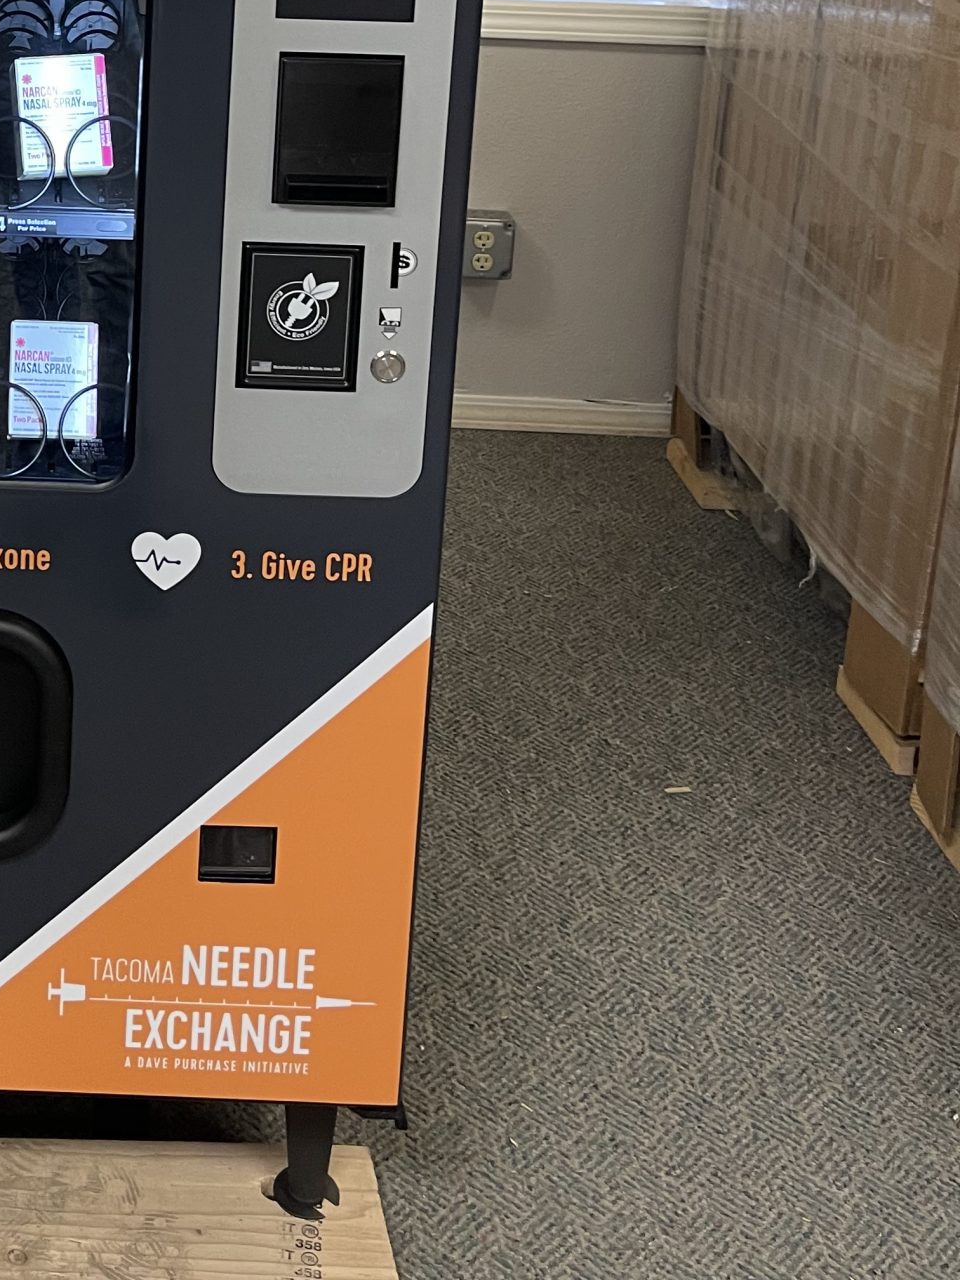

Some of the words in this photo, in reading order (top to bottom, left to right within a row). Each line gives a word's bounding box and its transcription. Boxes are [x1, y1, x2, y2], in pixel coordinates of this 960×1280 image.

[305, 316, 326, 336] Friendly
[14, 350, 50, 362] NARCAN
[14, 362, 42, 374] NASAL
[44, 363, 72, 375] SPRAY
[231, 549, 253, 579] 3.
[261, 550, 316, 581] Give
[325, 552, 373, 582] CPR
[90, 957, 175, 984] TACOMA
[181, 944, 316, 990] NEEDLE
[124, 1008, 312, 1055] EXCHANGE
[124, 1056, 132, 1068] A
[137, 1056, 168, 1070] DAVE
[174, 1058, 237, 1072] PURCHASE
[242, 1060, 309, 1075] INITIATIVE
[295, 1238, 322, 1252] 358
